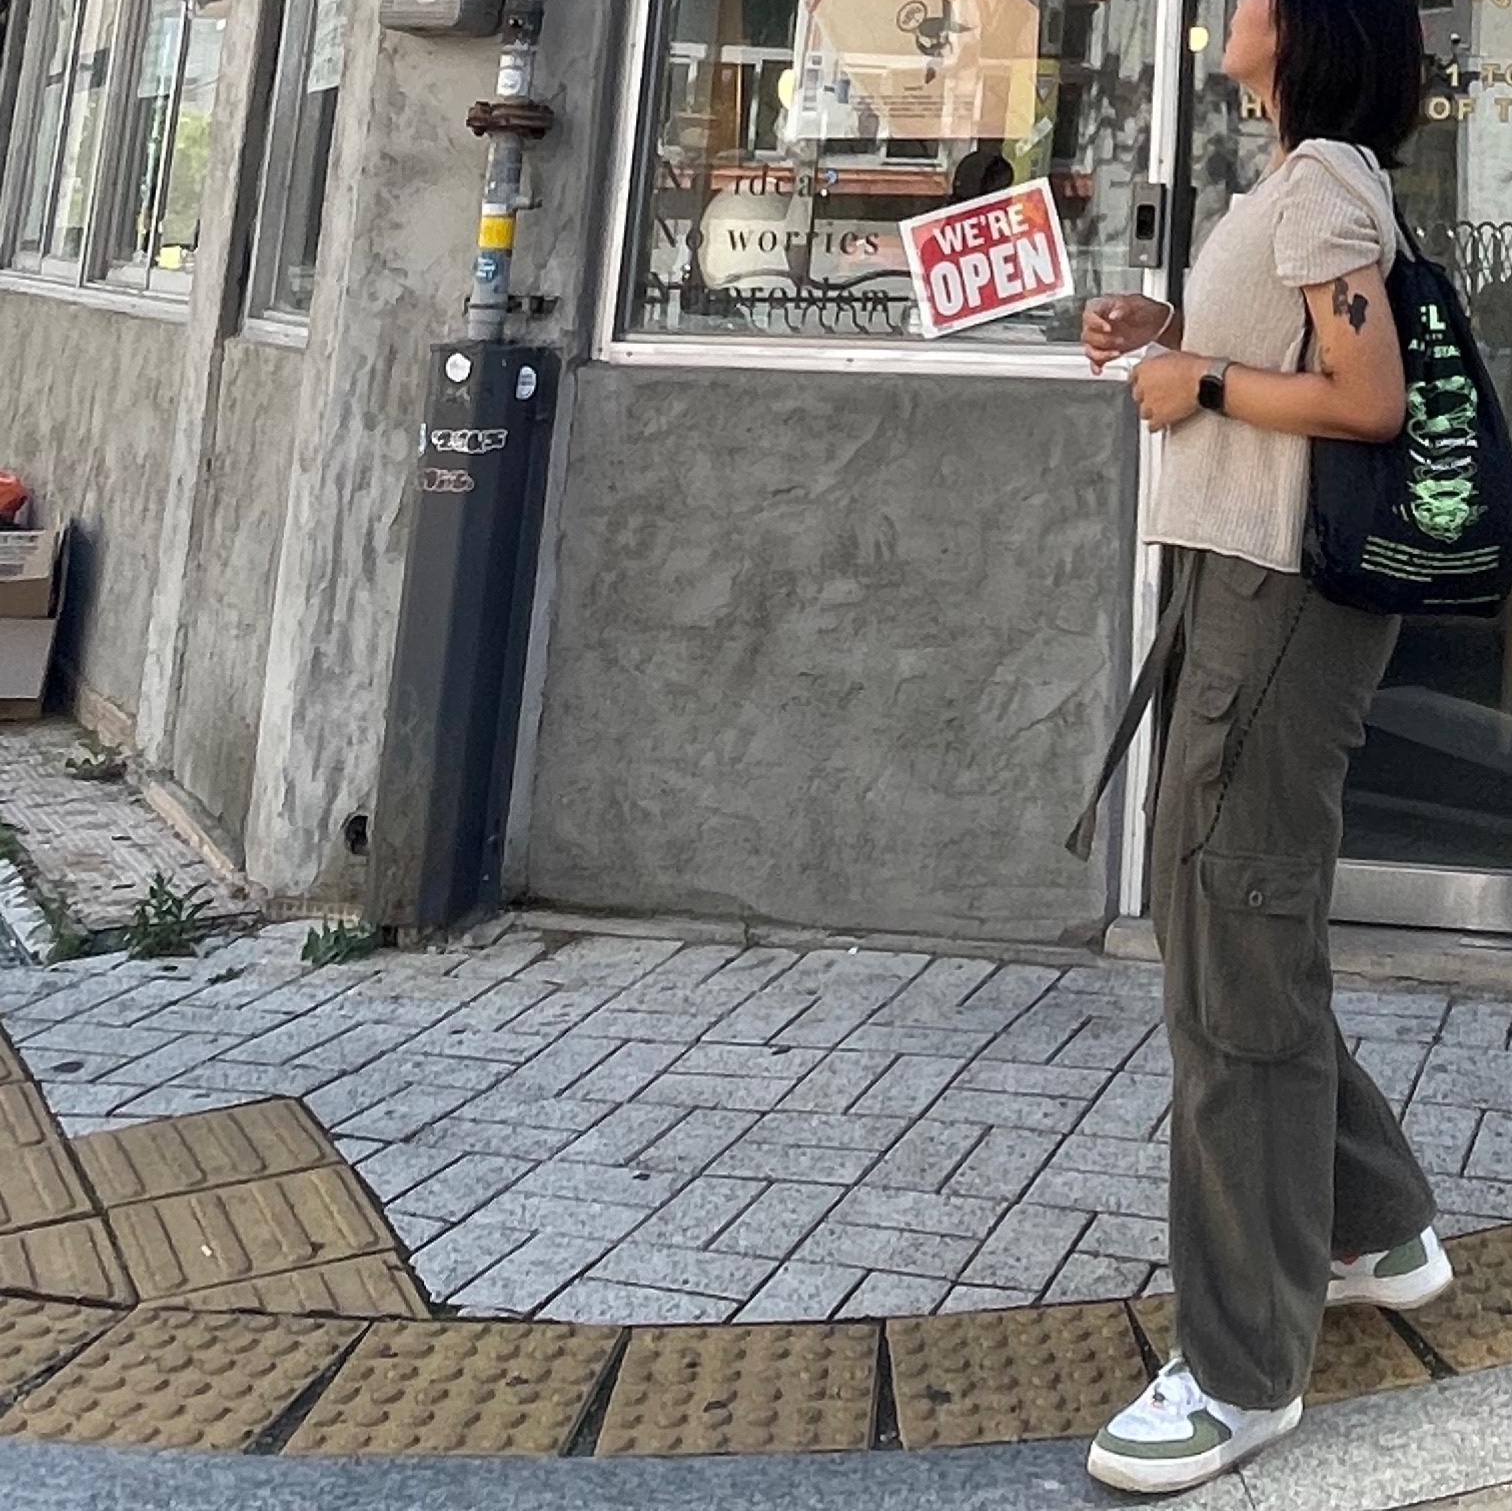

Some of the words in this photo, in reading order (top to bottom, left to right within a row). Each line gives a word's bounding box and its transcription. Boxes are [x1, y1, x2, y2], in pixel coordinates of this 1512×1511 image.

[1428, 98, 1476, 120] OF
[727, 221, 880, 256] worries
[932, 202, 1029, 255] WE'RE
[929, 232, 1056, 317] OPEN
